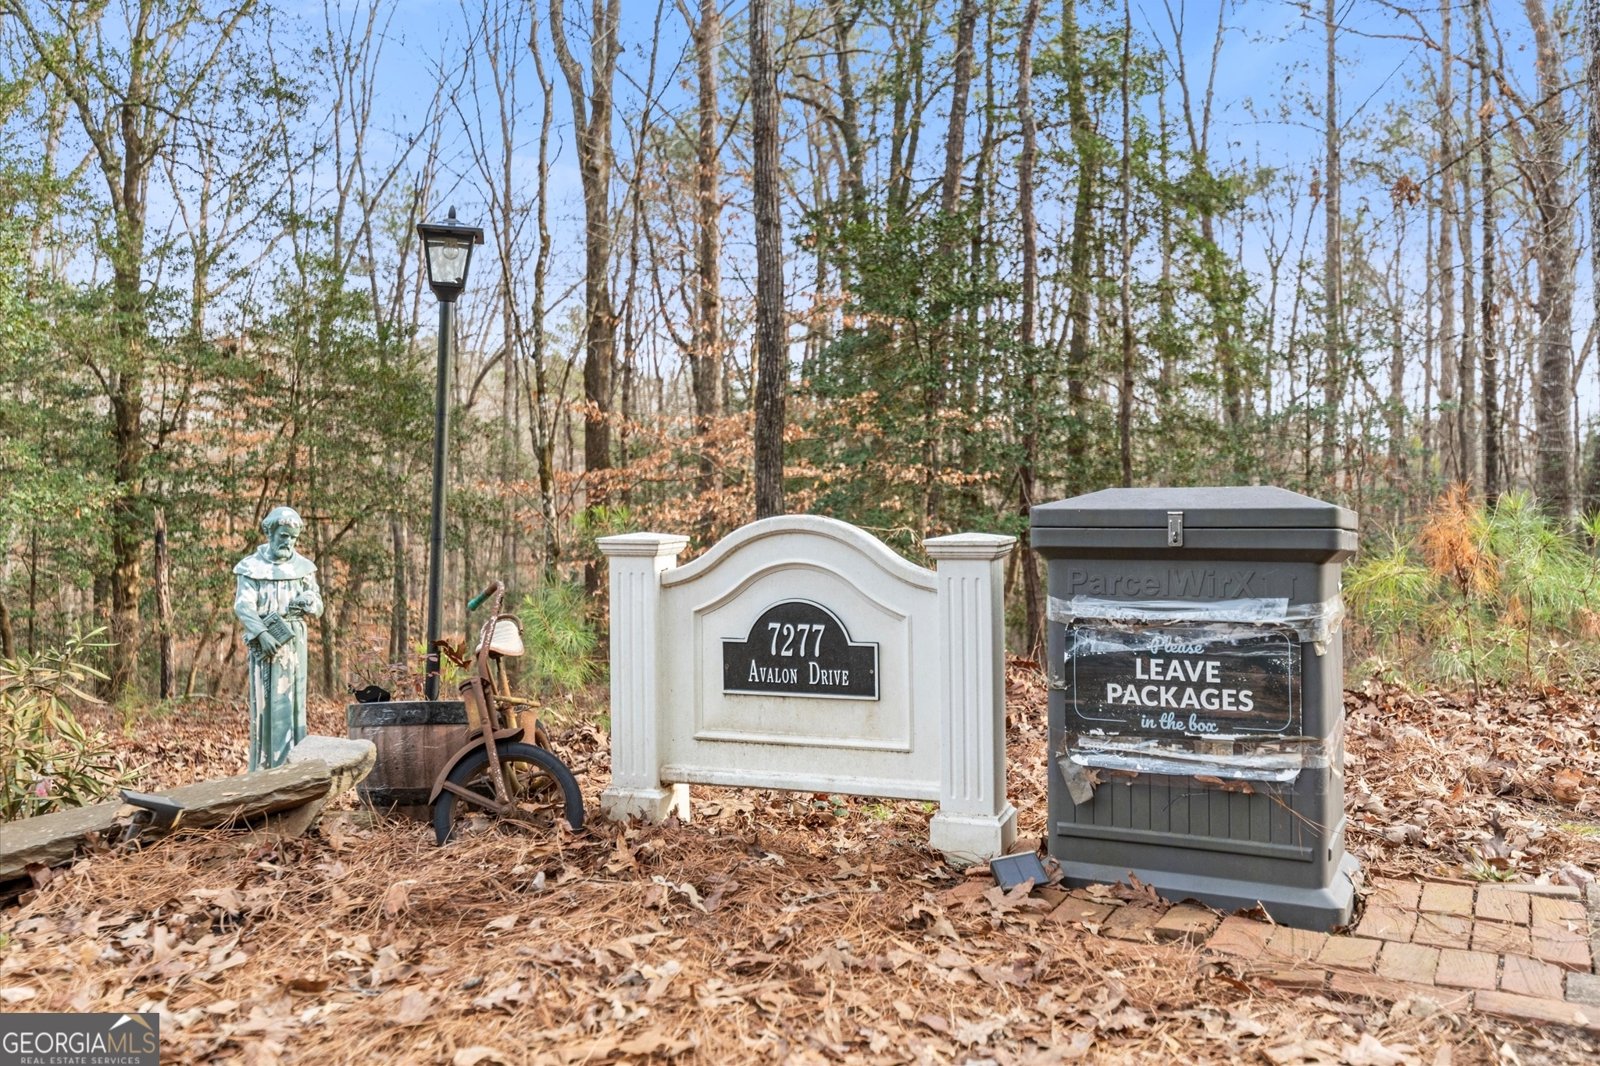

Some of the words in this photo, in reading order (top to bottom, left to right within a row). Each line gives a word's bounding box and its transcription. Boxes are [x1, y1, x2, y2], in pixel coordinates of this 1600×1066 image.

[768, 622, 825, 657] 7277
[1148, 634, 1205, 655] Please
[748, 659, 798, 684] AVALON
[809, 661, 849, 686] DRIVE
[1136, 658, 1221, 683] LEAVE
[1106, 683, 1254, 712] PACKAGES
[1141, 714, 1157, 729] in
[1159, 712, 1186, 731] the
[1188, 713, 1219, 733] box
